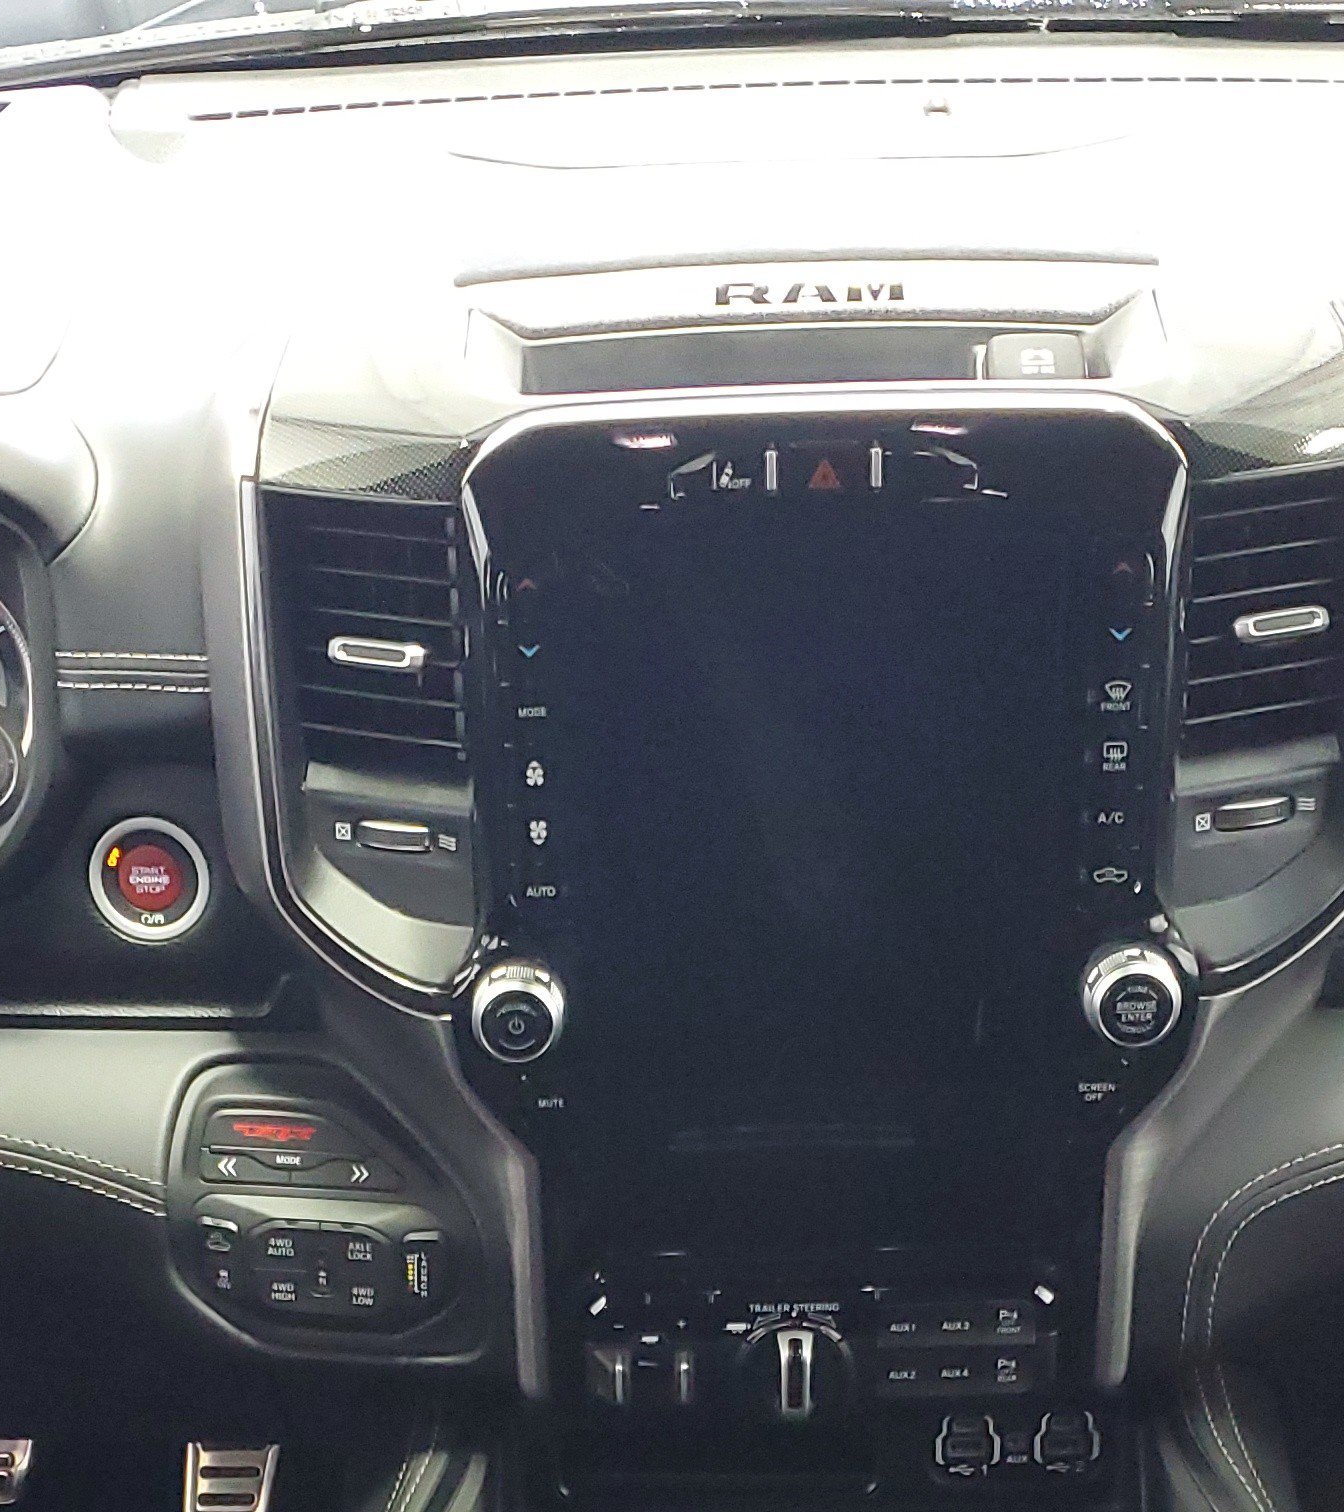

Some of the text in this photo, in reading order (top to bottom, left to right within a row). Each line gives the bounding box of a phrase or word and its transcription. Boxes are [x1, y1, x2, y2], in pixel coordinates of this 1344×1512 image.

[715, 283, 905, 305] RAM
[1097, 812, 1124, 824] A/C
[526, 886, 557, 898] AUTO
[1121, 1012, 1153, 1022] ENTER
[1078, 1082, 1116, 1092] SCREEN
[1084, 1092, 1103, 1101] OFF
[538, 1098, 565, 1109] MUTE
[275, 1154, 302, 1165] MODE
[268, 1237, 293, 1248] 4WD
[348, 1242, 373, 1252] AXLE
[267, 1247, 295, 1257] AUTO
[347, 1251, 373, 1261] LOCK
[271, 1282, 295, 1292] 4WD
[351, 1287, 374, 1297] 4WD
[271, 1292, 296, 1301] HIGH
[352, 1296, 374, 1306] LOW
[749, 1303, 840, 1313] TRAILER STEERING
[890, 1323, 910, 1332] AUX
[941, 1321, 962, 1331] AUX
[888, 1371, 908, 1380] AUX
[941, 1368, 961, 1378] AUX
[1006, 1454, 1028, 1464] AUX
